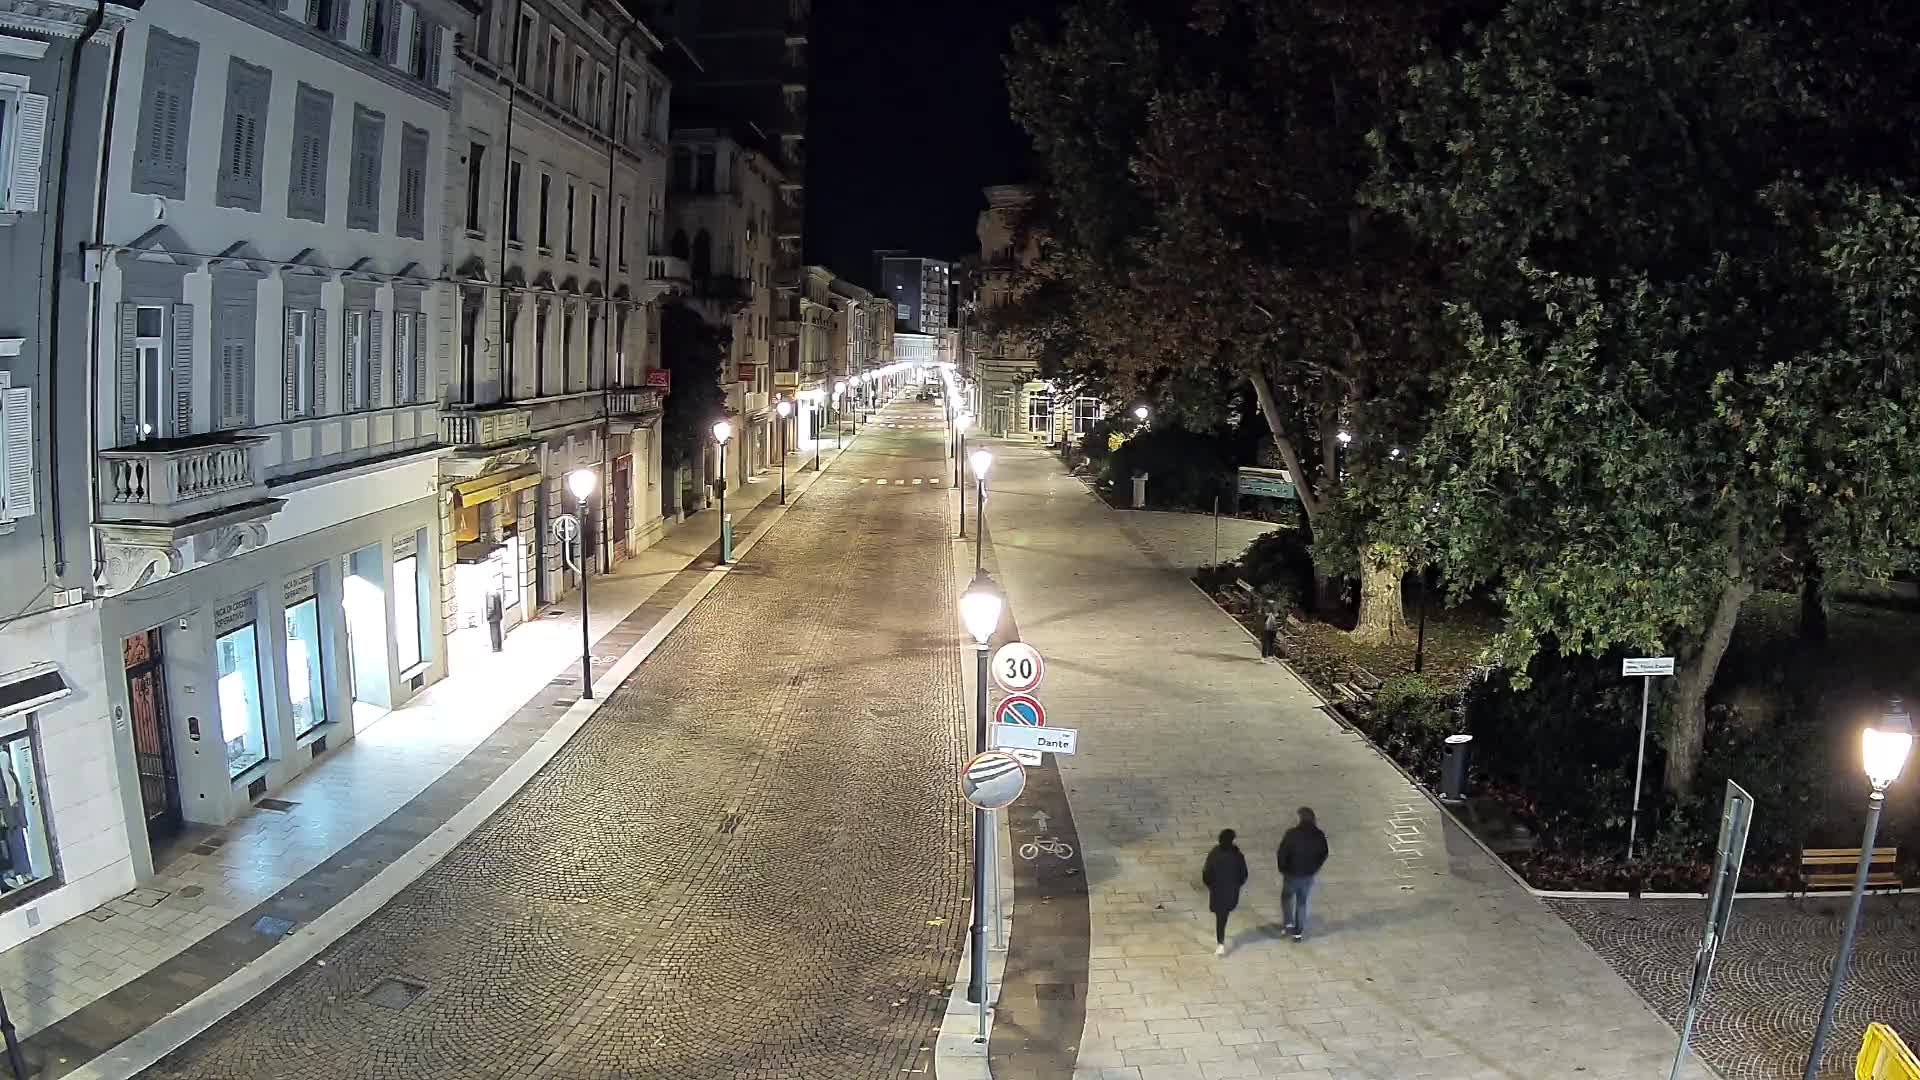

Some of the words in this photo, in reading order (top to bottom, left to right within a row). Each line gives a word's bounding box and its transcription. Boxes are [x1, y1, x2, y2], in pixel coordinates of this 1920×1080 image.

[215, 611, 244, 628] OPERATIVO
[1006, 658, 1032, 679] 30
[1037, 737, 1069, 748] Dante
